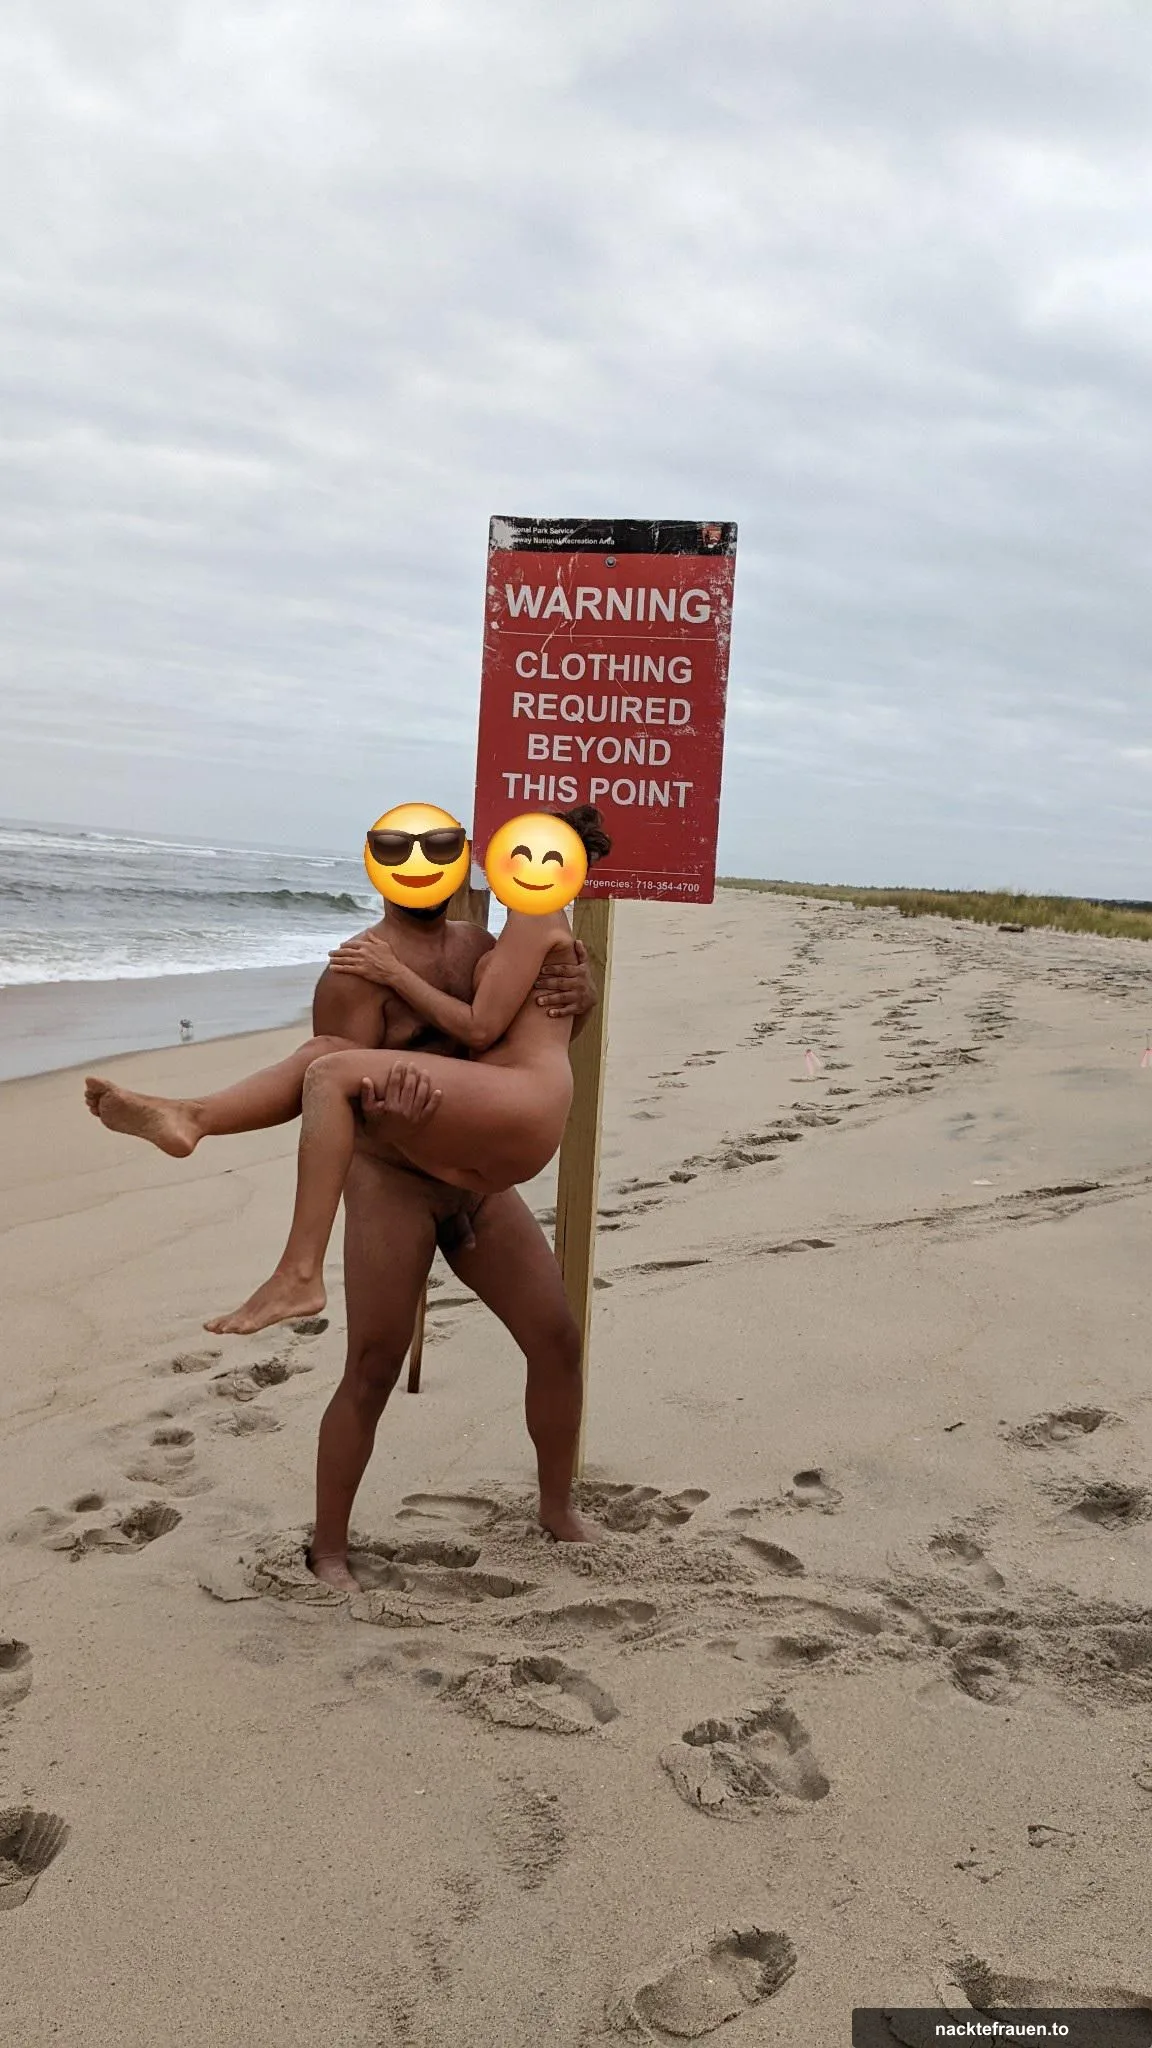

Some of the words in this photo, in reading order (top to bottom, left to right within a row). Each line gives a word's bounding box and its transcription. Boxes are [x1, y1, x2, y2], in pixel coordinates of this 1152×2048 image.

[506, 584, 711, 623] WARNING
[516, 652, 692, 683] CLOTHING
[513, 692, 691, 726] REQUIRED
[527, 734, 671, 766] BEYOND
[503, 773, 578, 803] THIS
[589, 778, 694, 808] POINT
[636, 880, 700, 892] 718-354-4700
